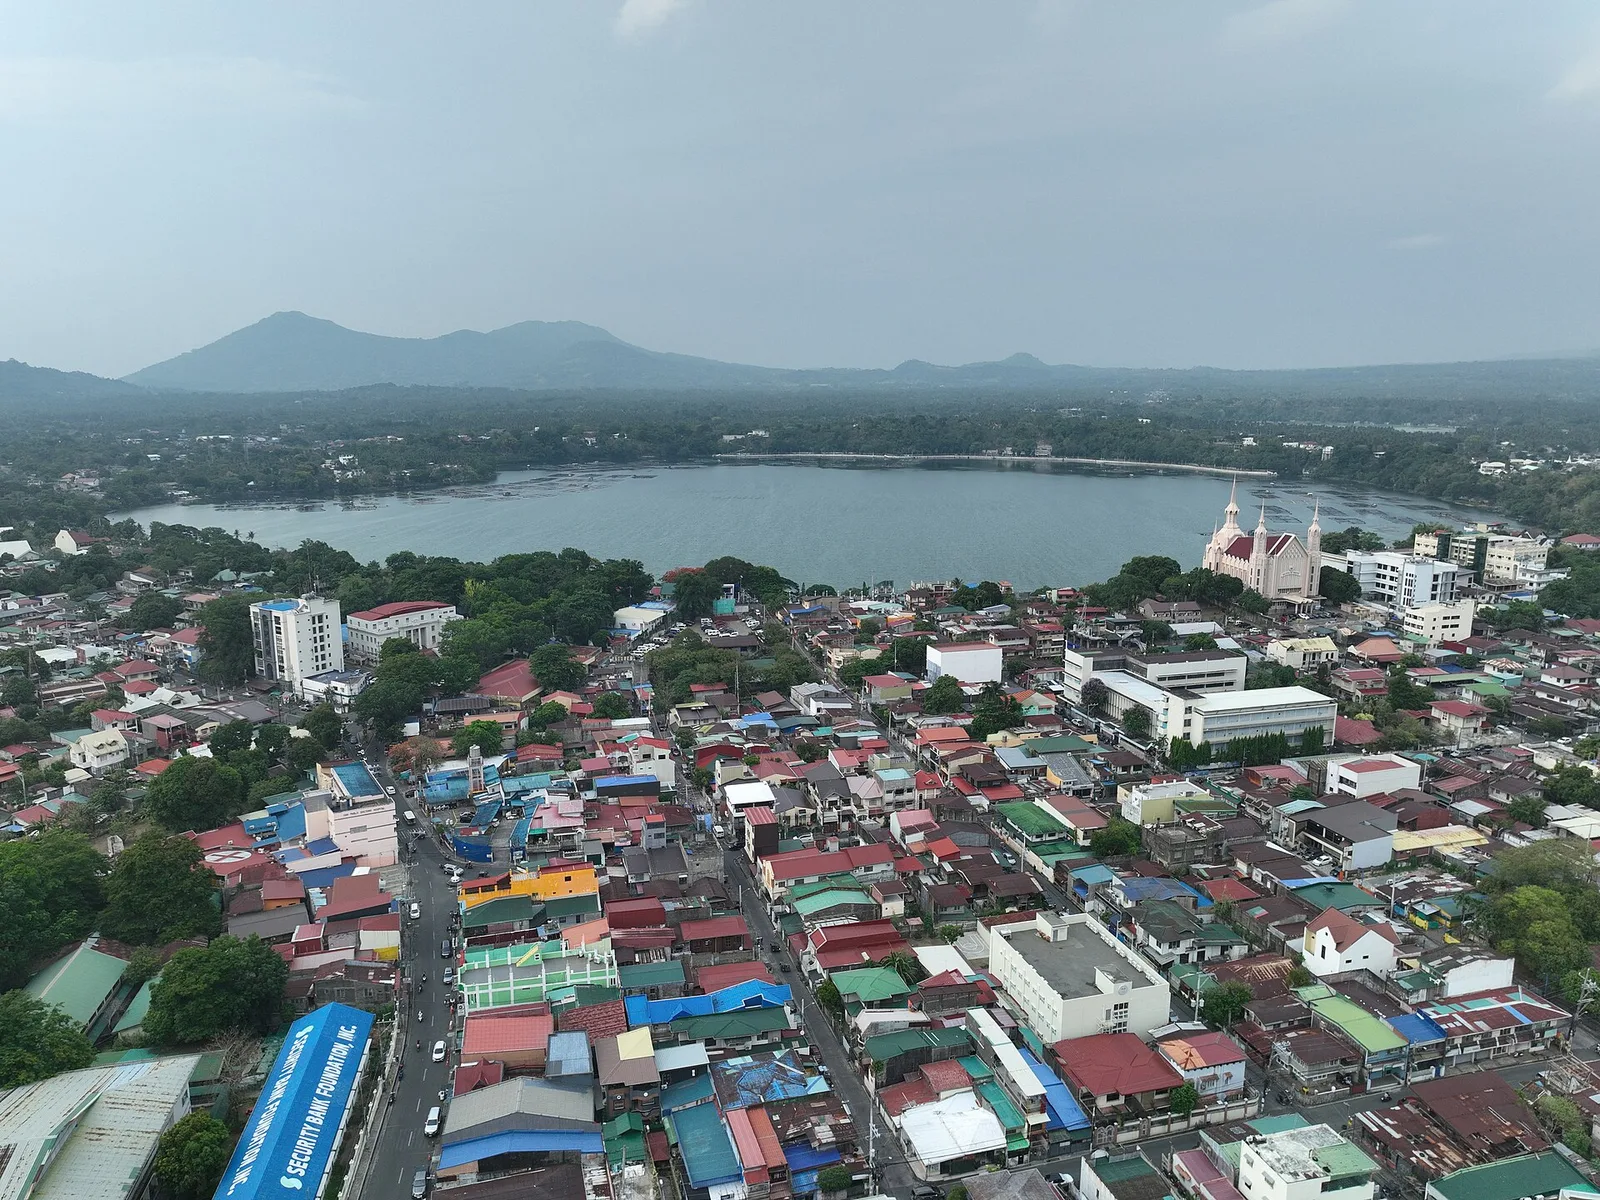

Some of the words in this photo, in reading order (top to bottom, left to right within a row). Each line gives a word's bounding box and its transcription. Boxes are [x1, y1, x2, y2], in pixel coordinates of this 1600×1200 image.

[337, 1025, 358, 1042] INC.
[315, 1041, 355, 1098] FOUNDATION,
[306, 1096, 331, 1126] BANK
[286, 1122, 320, 1177] SECURITY
